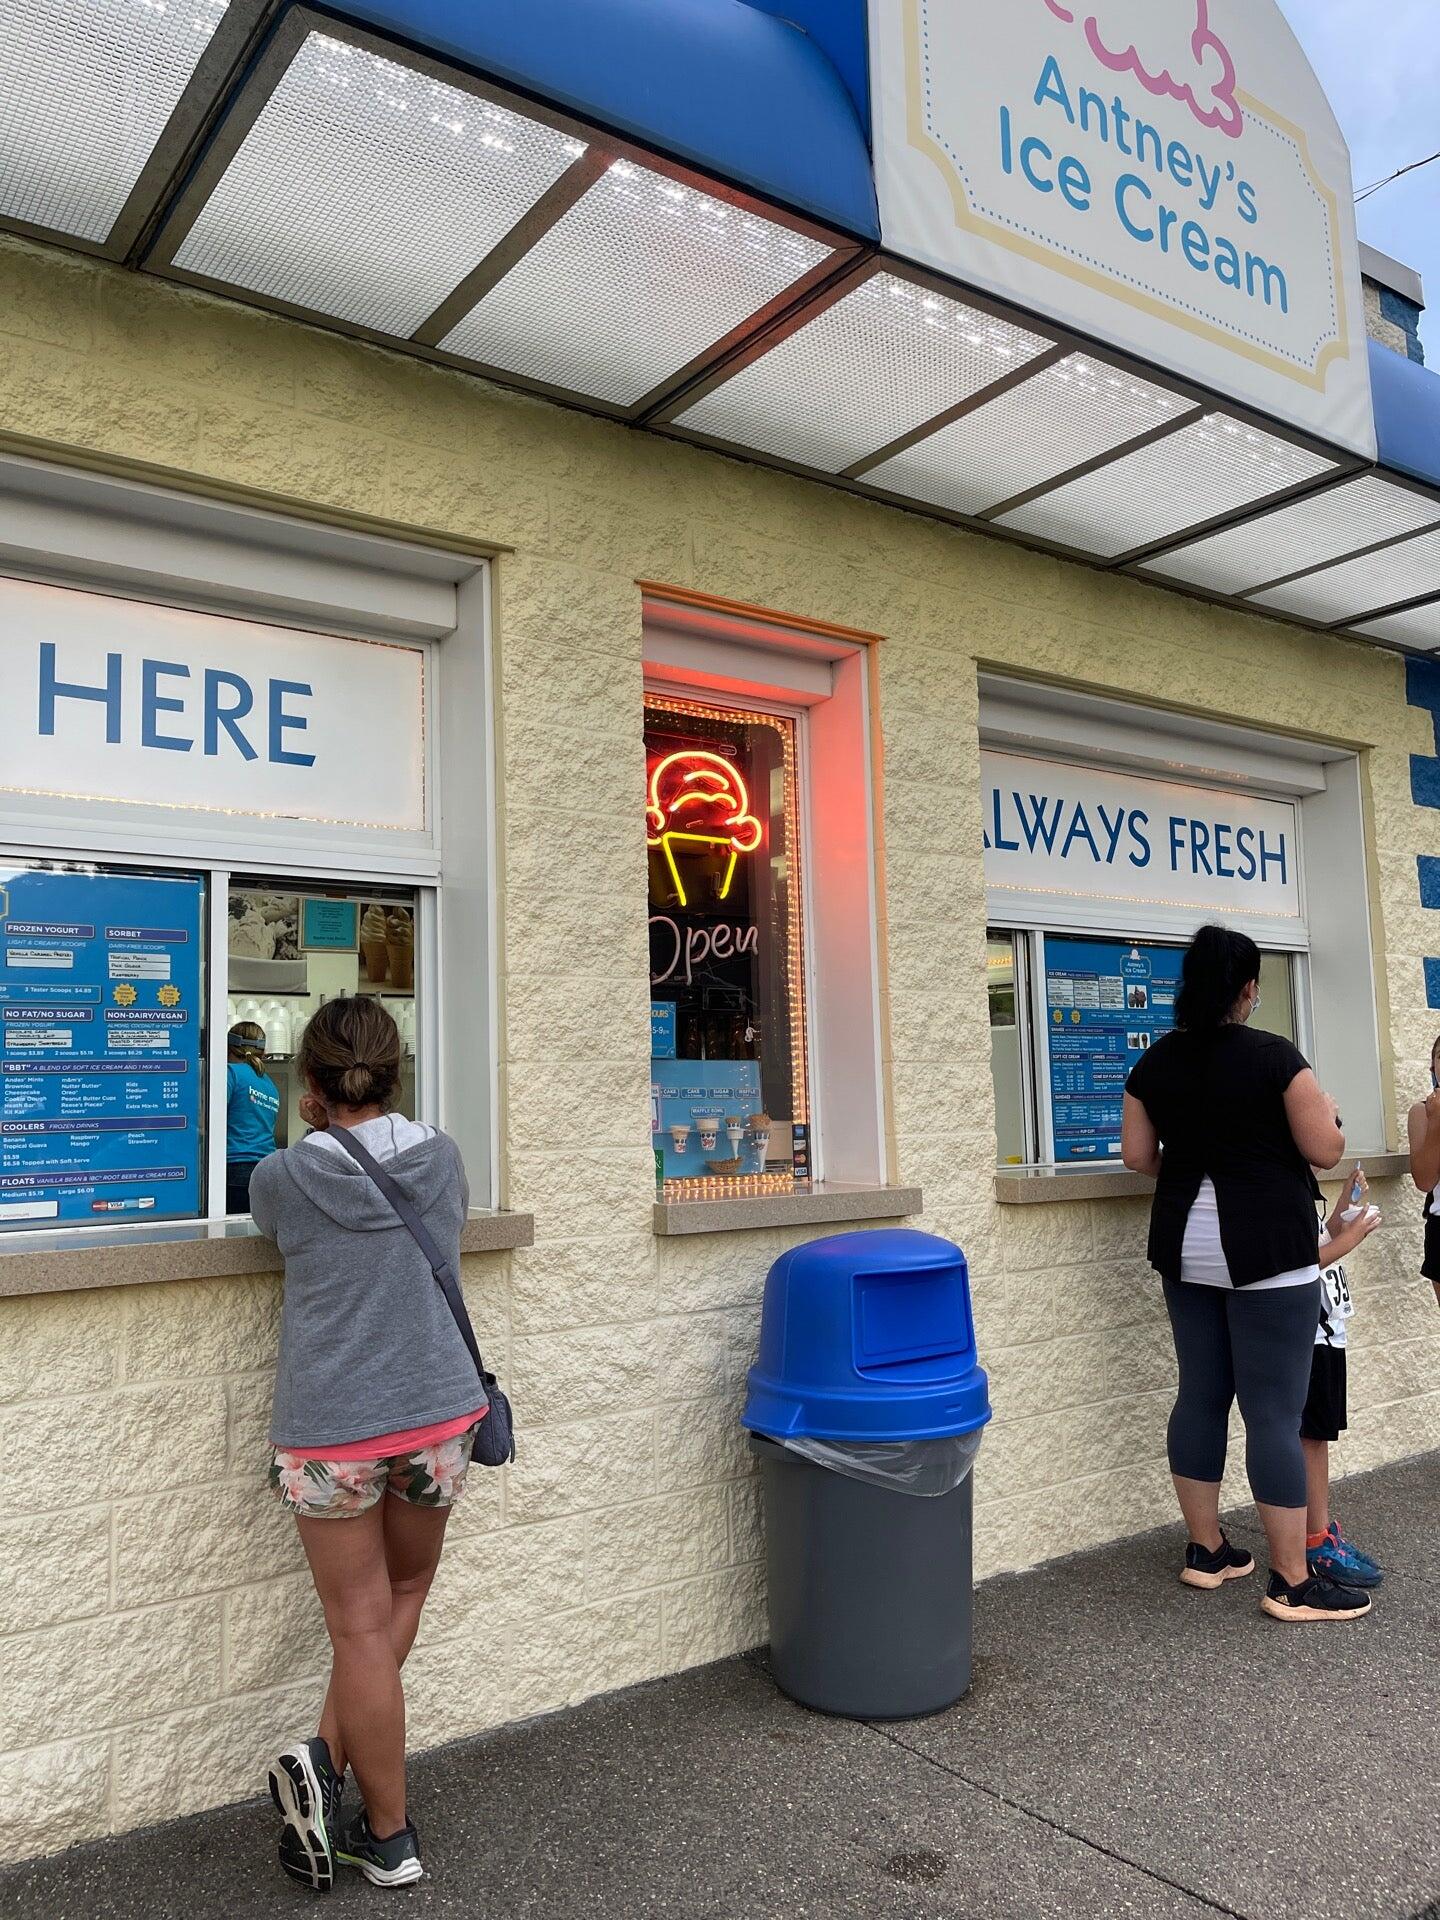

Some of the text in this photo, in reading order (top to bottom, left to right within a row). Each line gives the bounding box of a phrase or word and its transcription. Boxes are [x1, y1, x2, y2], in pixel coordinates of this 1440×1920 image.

[1033, 55, 1258, 224] Antney's
[1000, 105, 1289, 314] Ice Cream
[38, 641, 317, 768] HERE
[983, 788, 1287, 885] LWAYS FRESH
[7, 924, 80, 934] FROZEN YOGURT
[109, 929, 142, 938] SORBET
[6, 1010, 85, 1019] NO FAT/NO SUGAR
[107, 1011, 183, 1020] NON-DAIRY/VEGAN
[249, 1085, 268, 1101] home
[3, 1123, 45, 1131] COOLERS
[1, 1177, 35, 1186] FLOATS
[1325, 1265, 1350, 1306] 39
